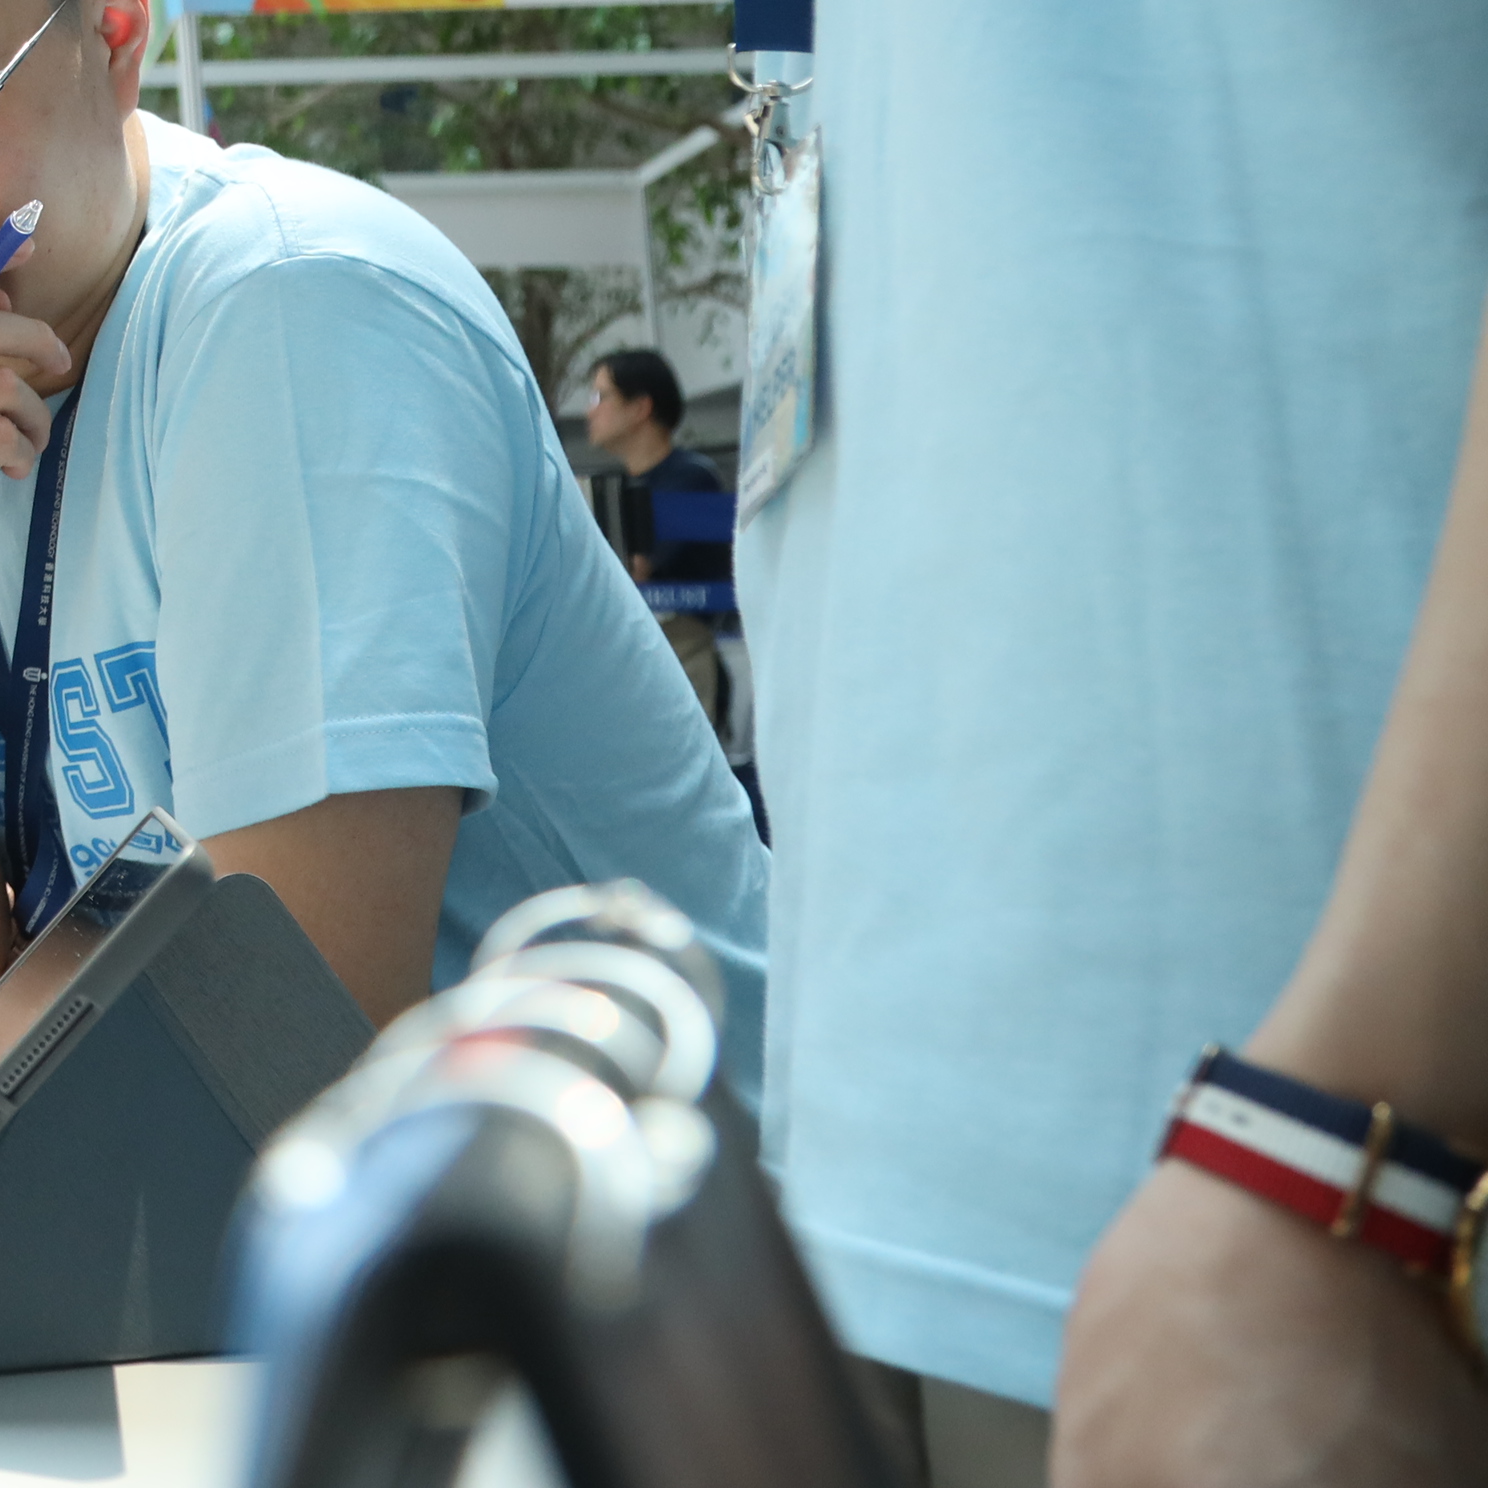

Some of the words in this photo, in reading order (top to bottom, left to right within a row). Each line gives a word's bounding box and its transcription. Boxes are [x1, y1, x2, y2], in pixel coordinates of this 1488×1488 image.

[56, 460, 65, 490] SCIENCE
[47, 510, 59, 558] TECHNOLOGY
[37, 562, 54, 626] 香港科技大學
[27, 696, 35, 718] HONG
